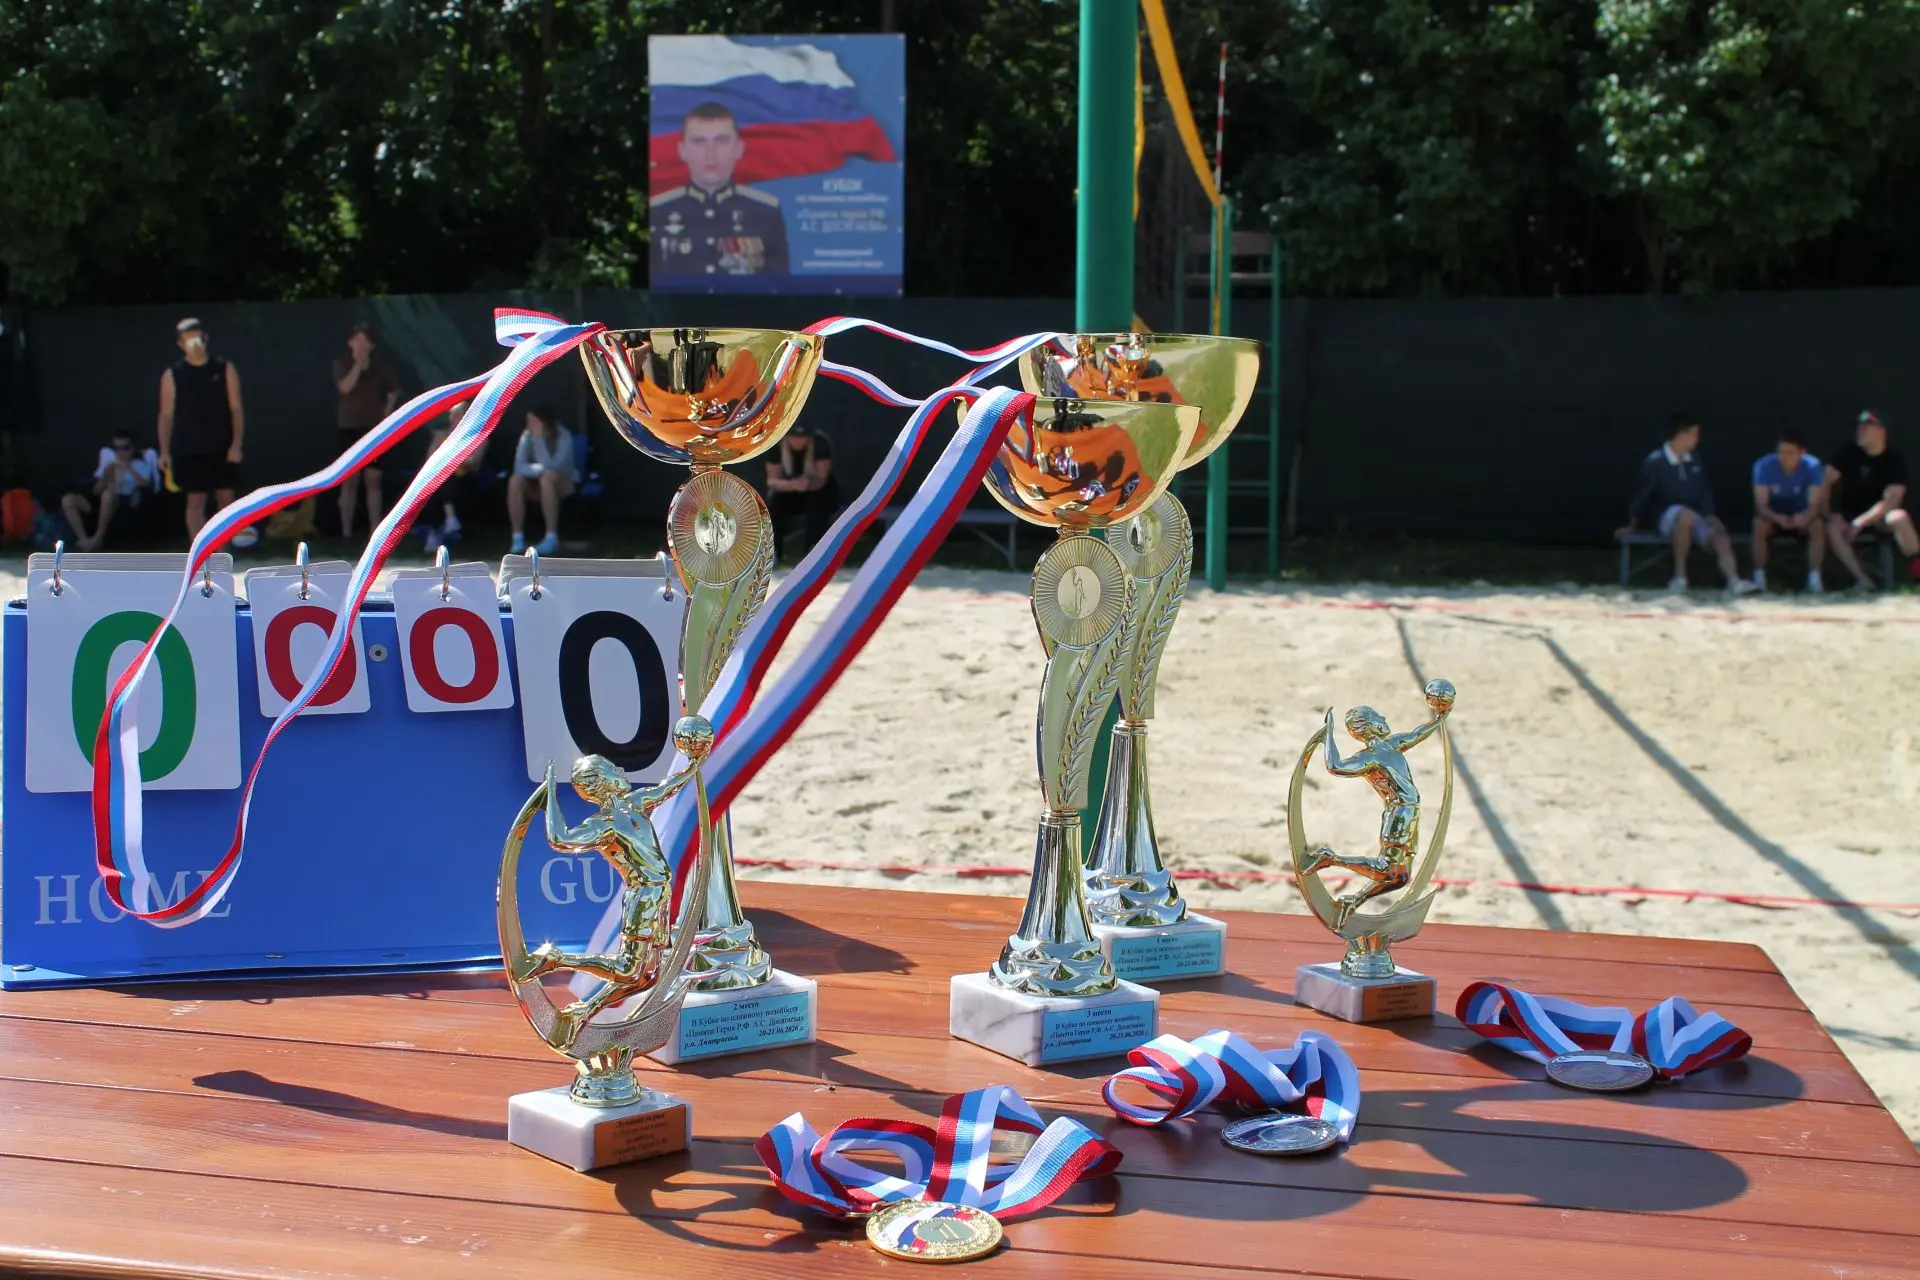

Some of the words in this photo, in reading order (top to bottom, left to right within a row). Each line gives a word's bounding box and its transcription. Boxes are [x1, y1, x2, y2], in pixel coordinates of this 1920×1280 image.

[72, 611, 196, 782] 0
[264, 606, 357, 706] 0
[409, 607, 500, 704] 0
[559, 610, 670, 772] 0
[716, 1024, 736, 1034] Героя
[1092, 1009, 1112, 1017] место
